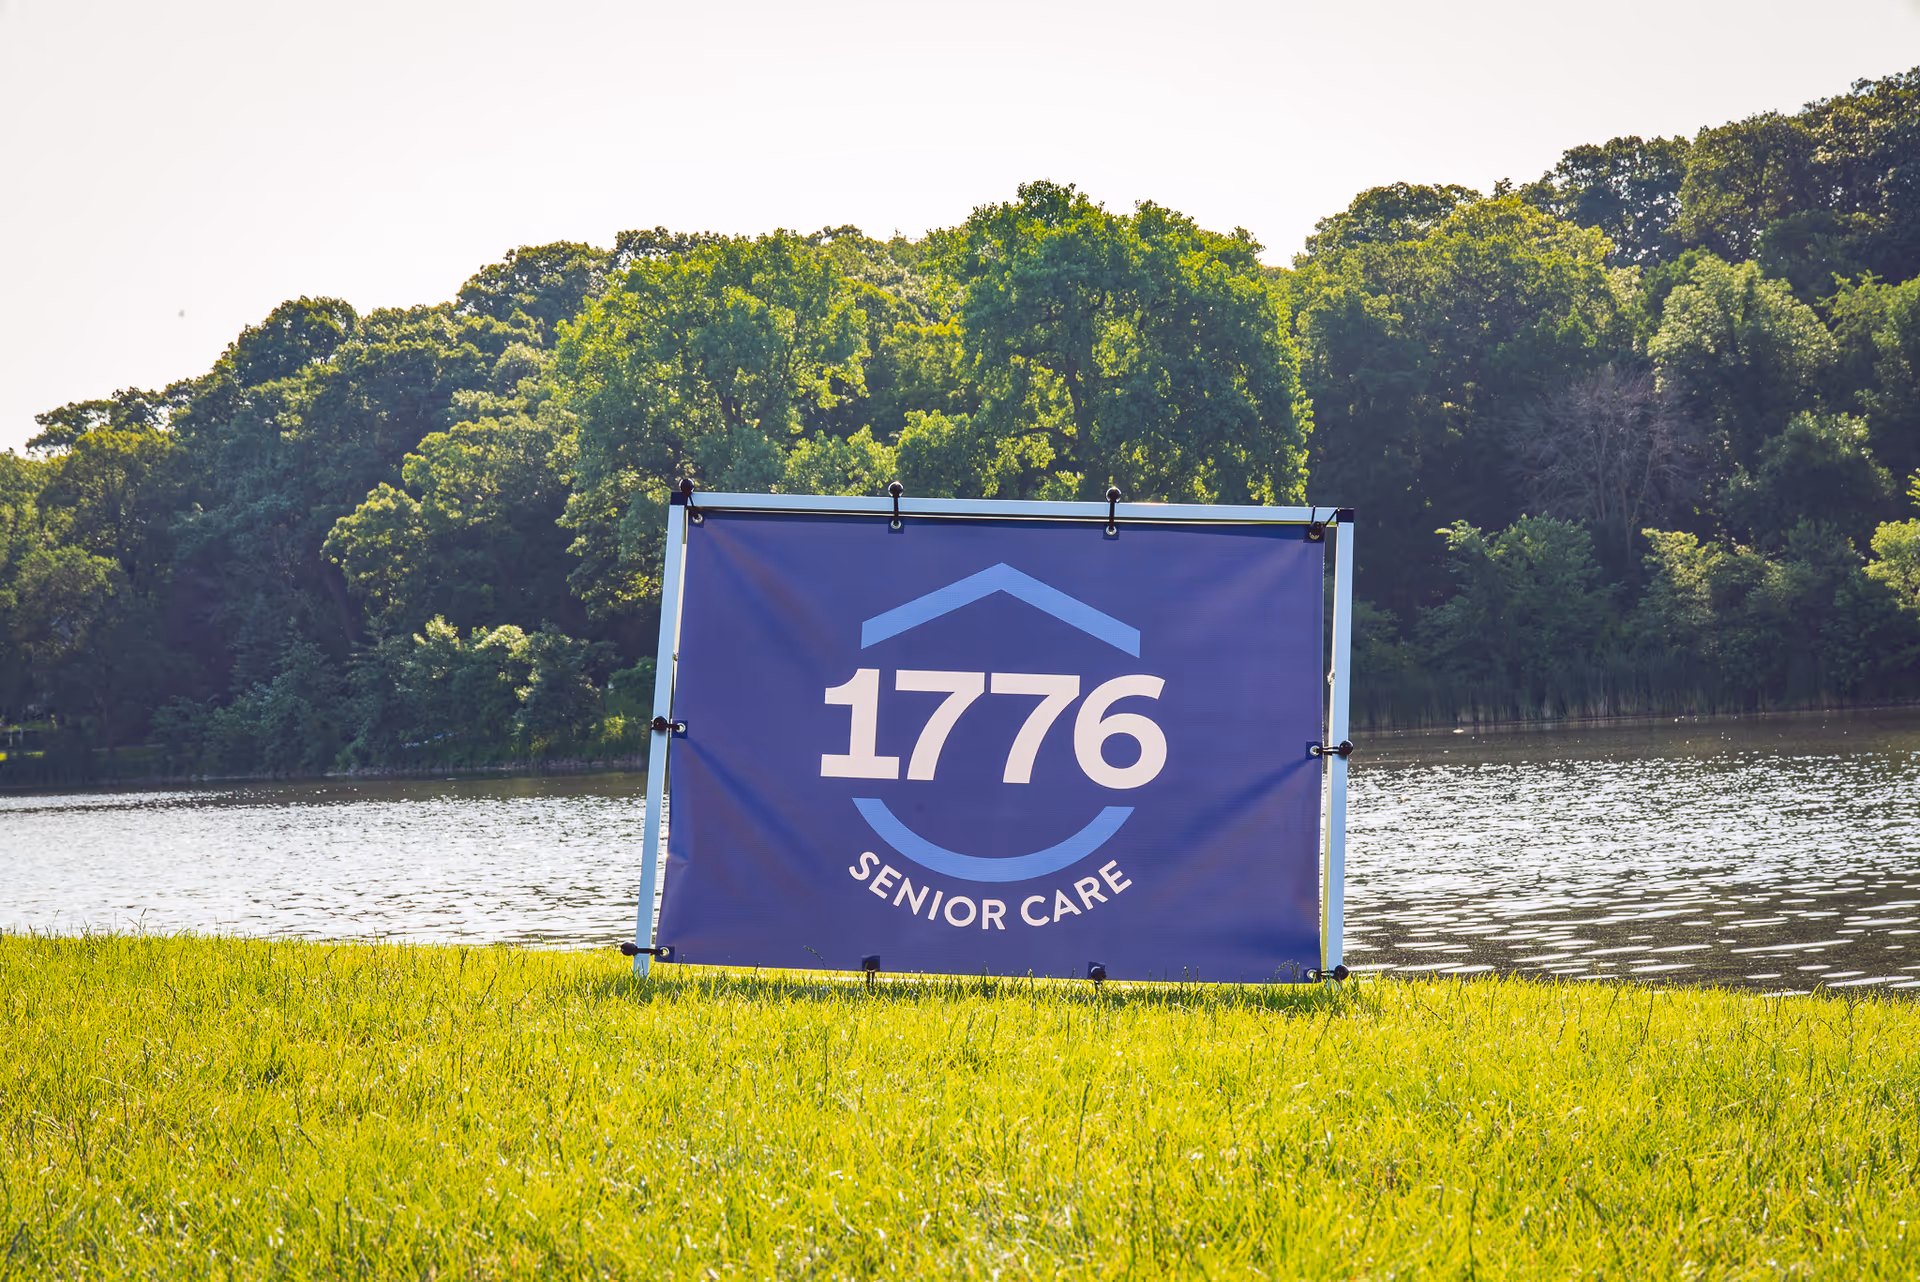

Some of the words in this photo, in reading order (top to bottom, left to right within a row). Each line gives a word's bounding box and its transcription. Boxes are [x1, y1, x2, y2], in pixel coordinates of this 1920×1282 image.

[820, 668, 1168, 790] 1776
[848, 851, 1007, 930] SENIOR
[1020, 859, 1133, 927] CARE
